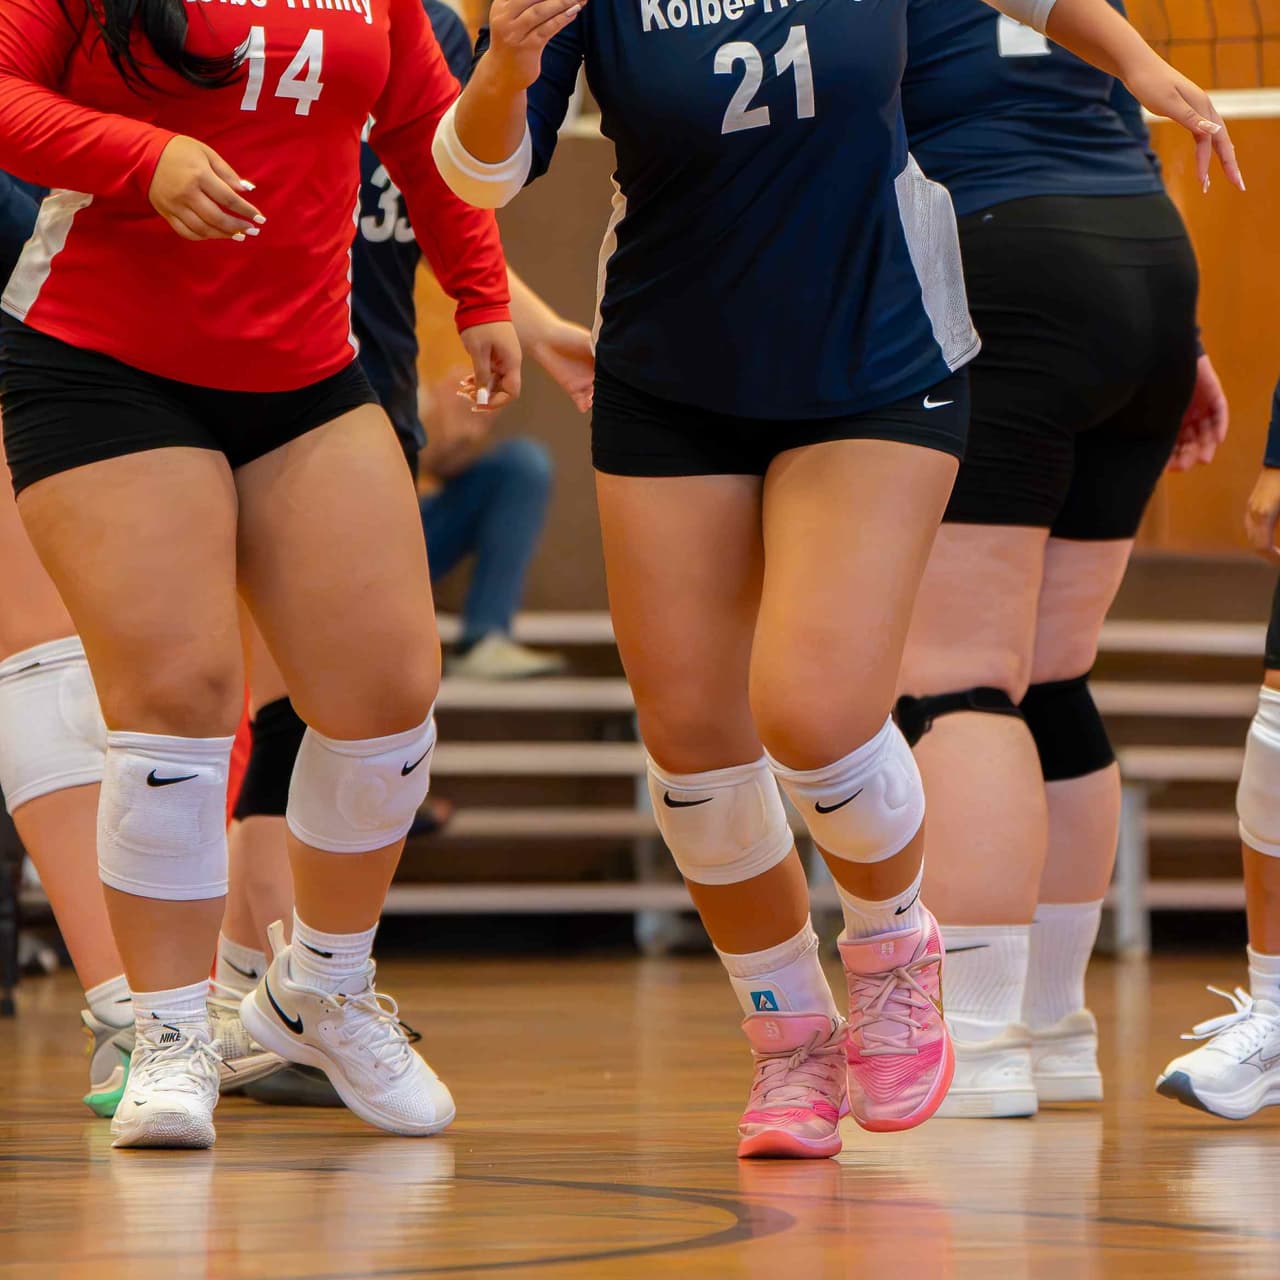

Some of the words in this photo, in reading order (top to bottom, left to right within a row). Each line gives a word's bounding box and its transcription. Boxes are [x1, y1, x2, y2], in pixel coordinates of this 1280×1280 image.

[233, 25, 324, 116] 14
[713, 24, 816, 135] 21
[360, 163, 417, 243] 3
[160, 1032, 181, 1044] NIKE
